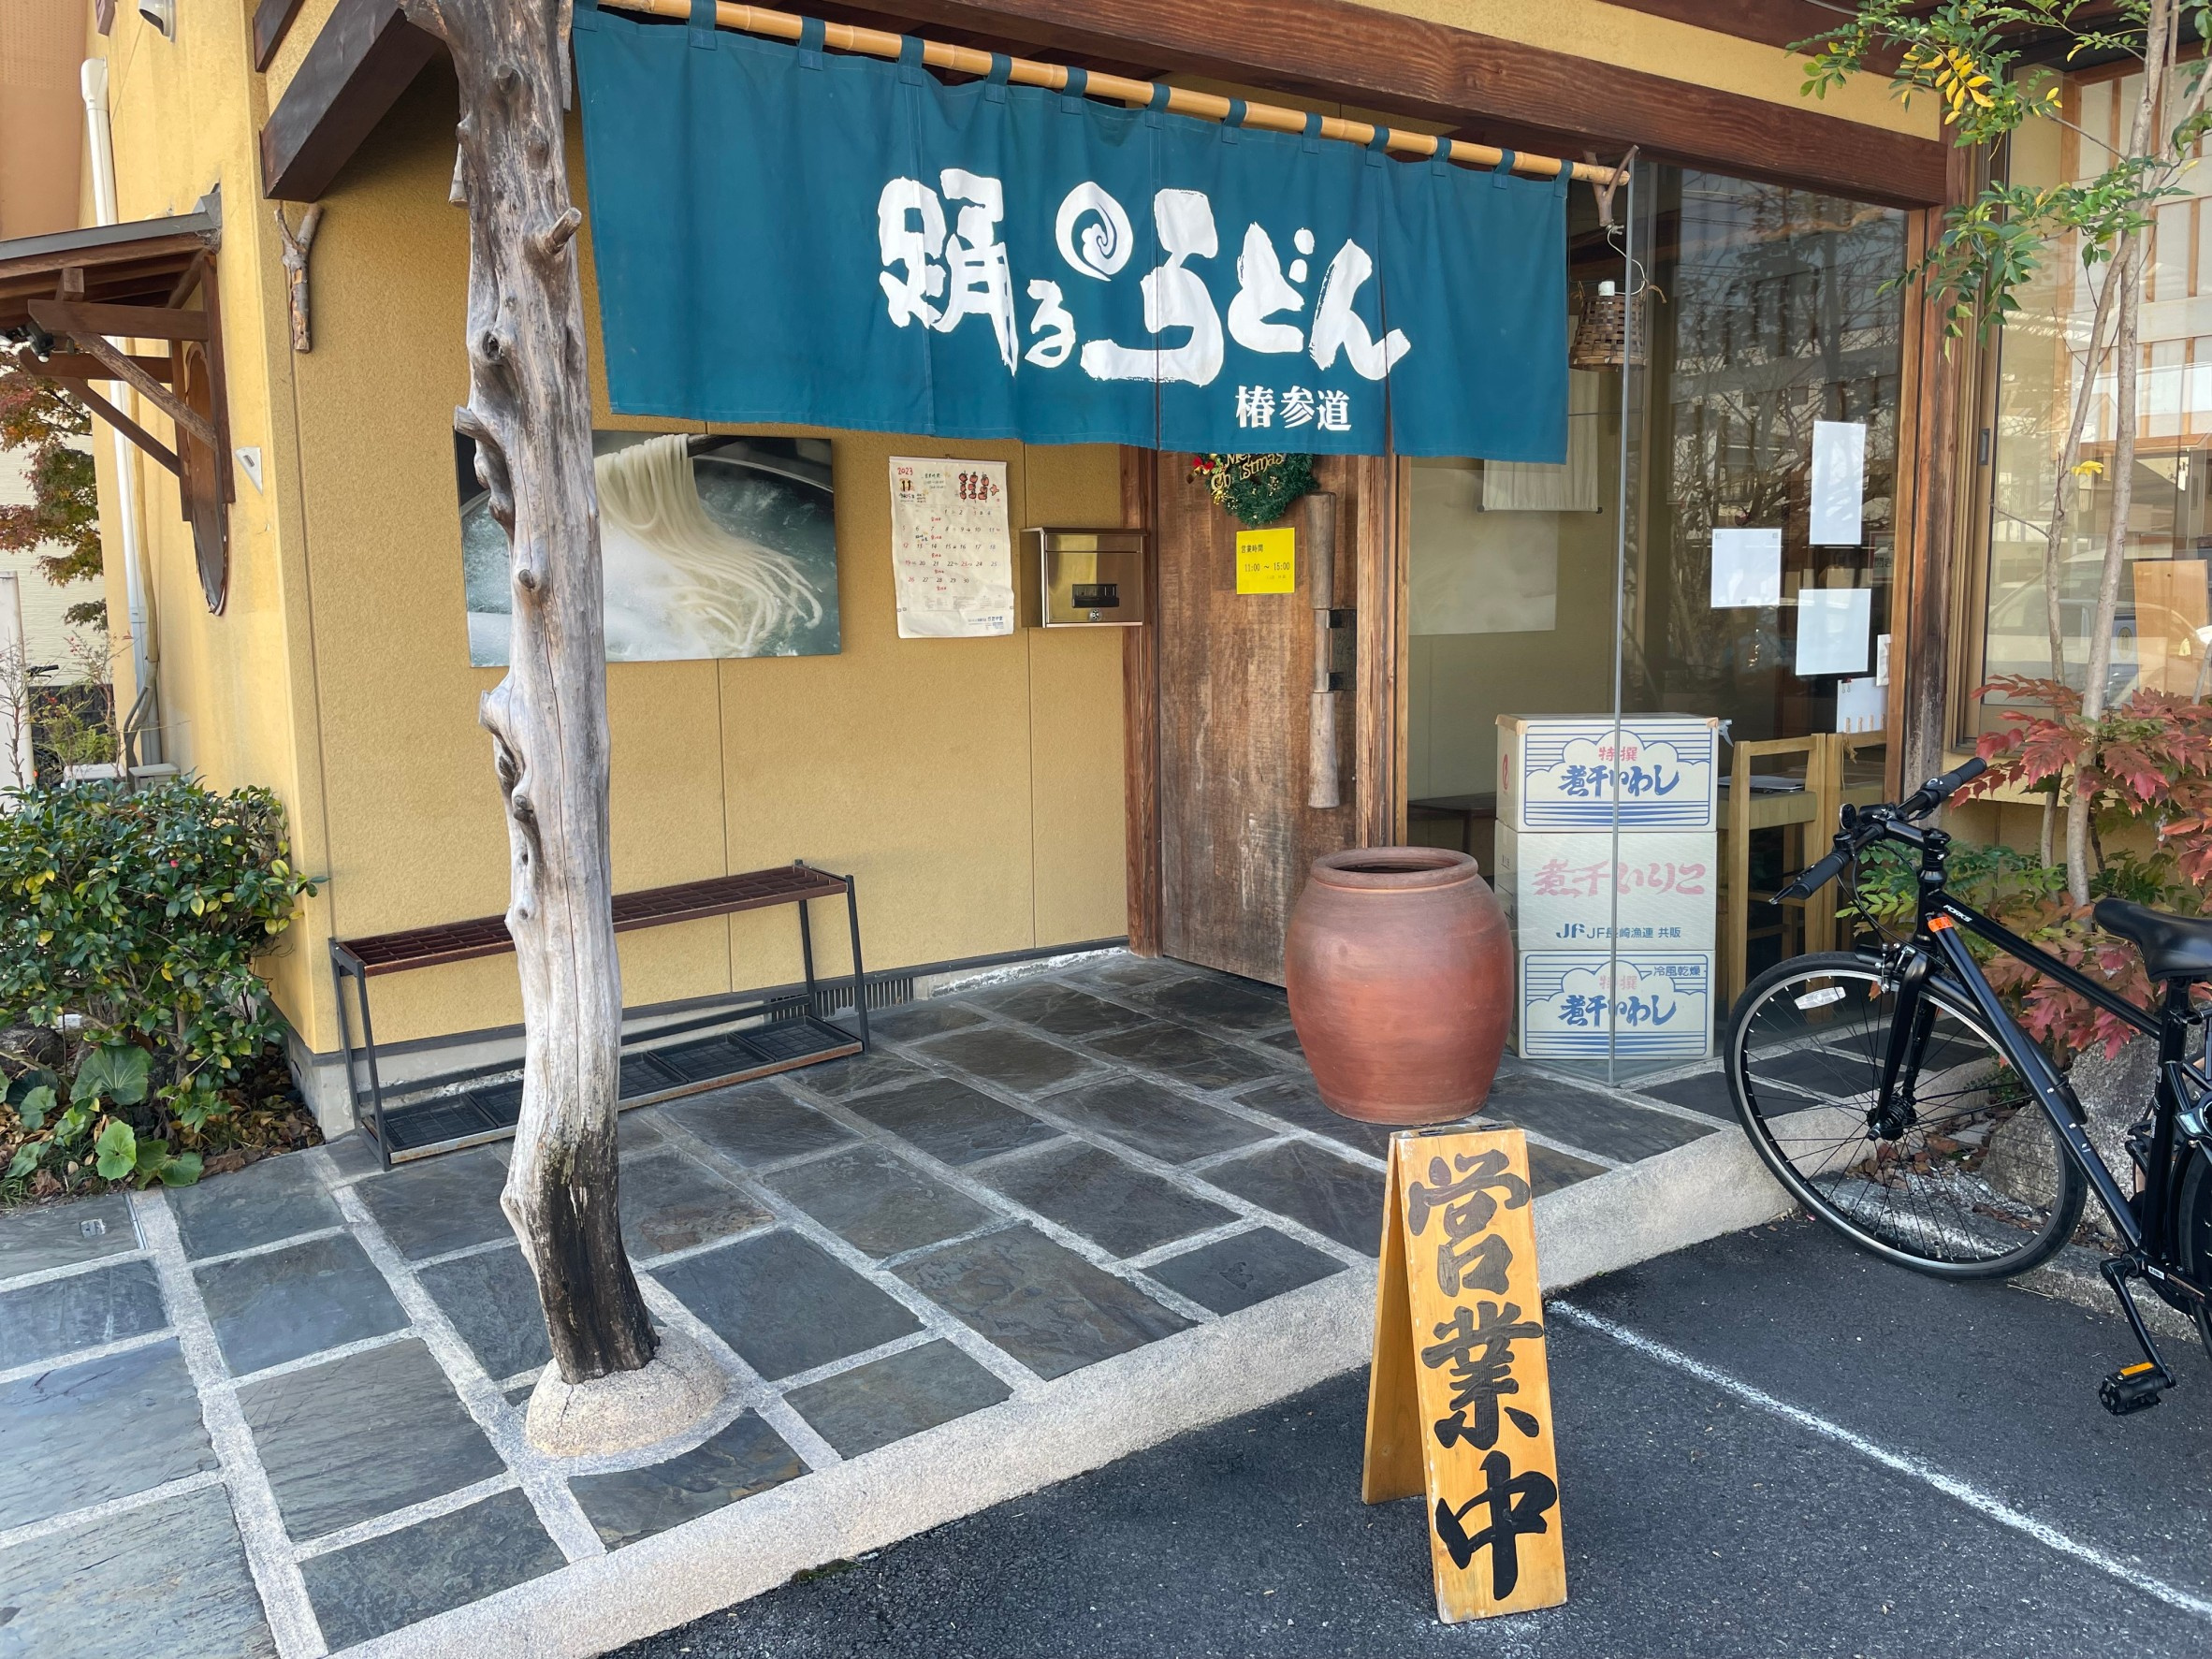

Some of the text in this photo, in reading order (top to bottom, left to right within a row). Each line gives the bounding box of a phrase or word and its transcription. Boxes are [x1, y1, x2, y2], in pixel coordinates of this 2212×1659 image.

[878, 168, 1411, 386] 踊るうどん
[1235, 386, 1352, 431] 椿参道
[897, 467, 913, 475] 2023
[1211, 454, 1286, 490] Chistmas
[1241, 544, 1263, 554] 営業時間
[1244, 563, 1260, 572] 11:00
[1273, 561, 1290, 571] 15:00
[1598, 746, 1638, 763] 特撰
[1558, 764, 1681, 798] 煮干いわし
[1531, 859, 1707, 898] 煮干いりこ
[1658, 927, 1681, 939] 共販
[1653, 966, 1701, 977] 冷風乾燥
[1558, 995, 1678, 1028] 煮干いわし
[1408, 1148, 1558, 1601] 営業中
